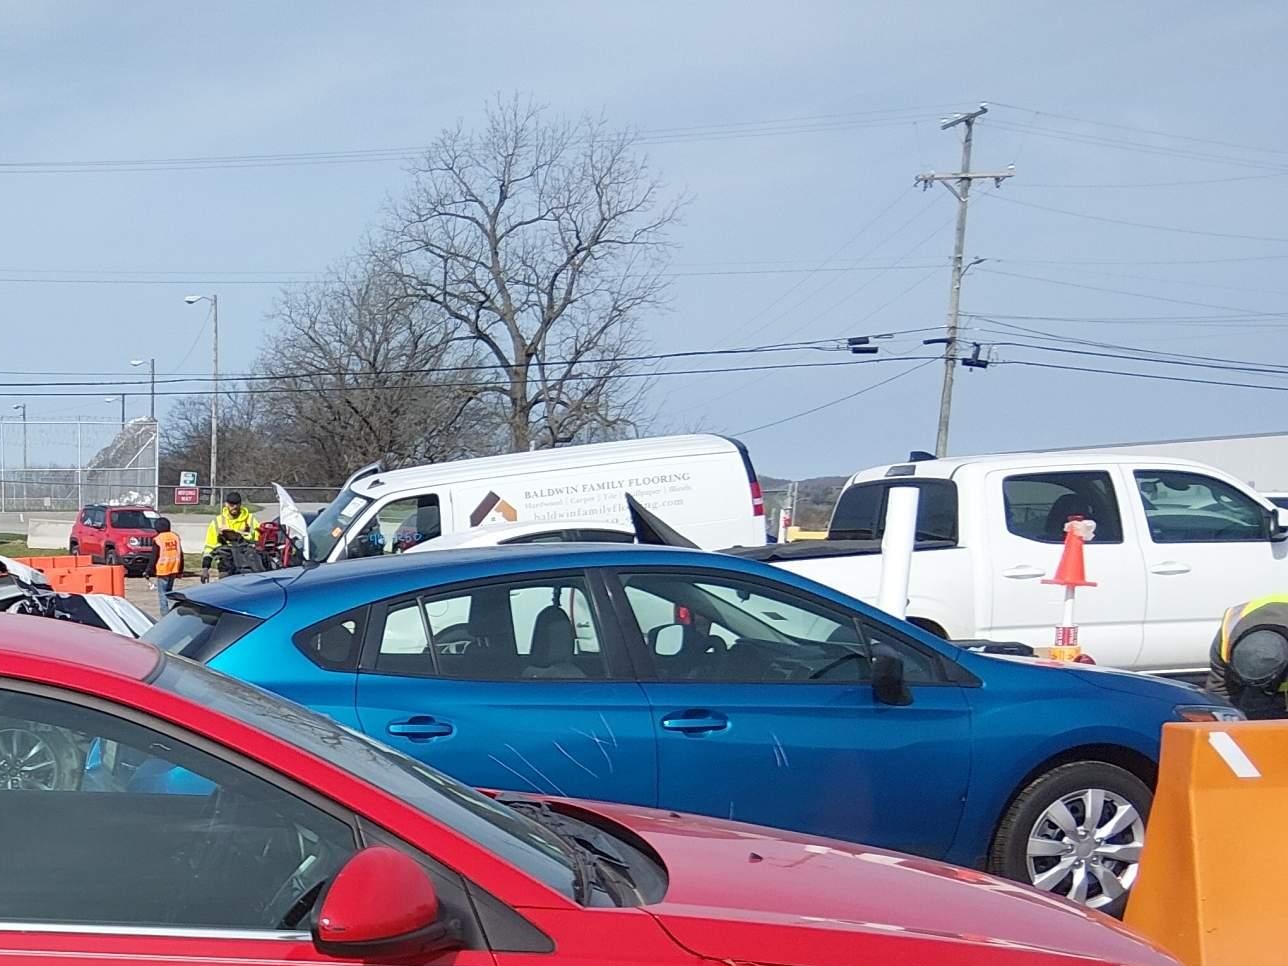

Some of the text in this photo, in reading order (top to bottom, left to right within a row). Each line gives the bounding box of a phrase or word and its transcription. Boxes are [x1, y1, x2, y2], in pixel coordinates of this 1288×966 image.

[524, 472, 691, 499] BALDWIN FAMILY FLOORING
